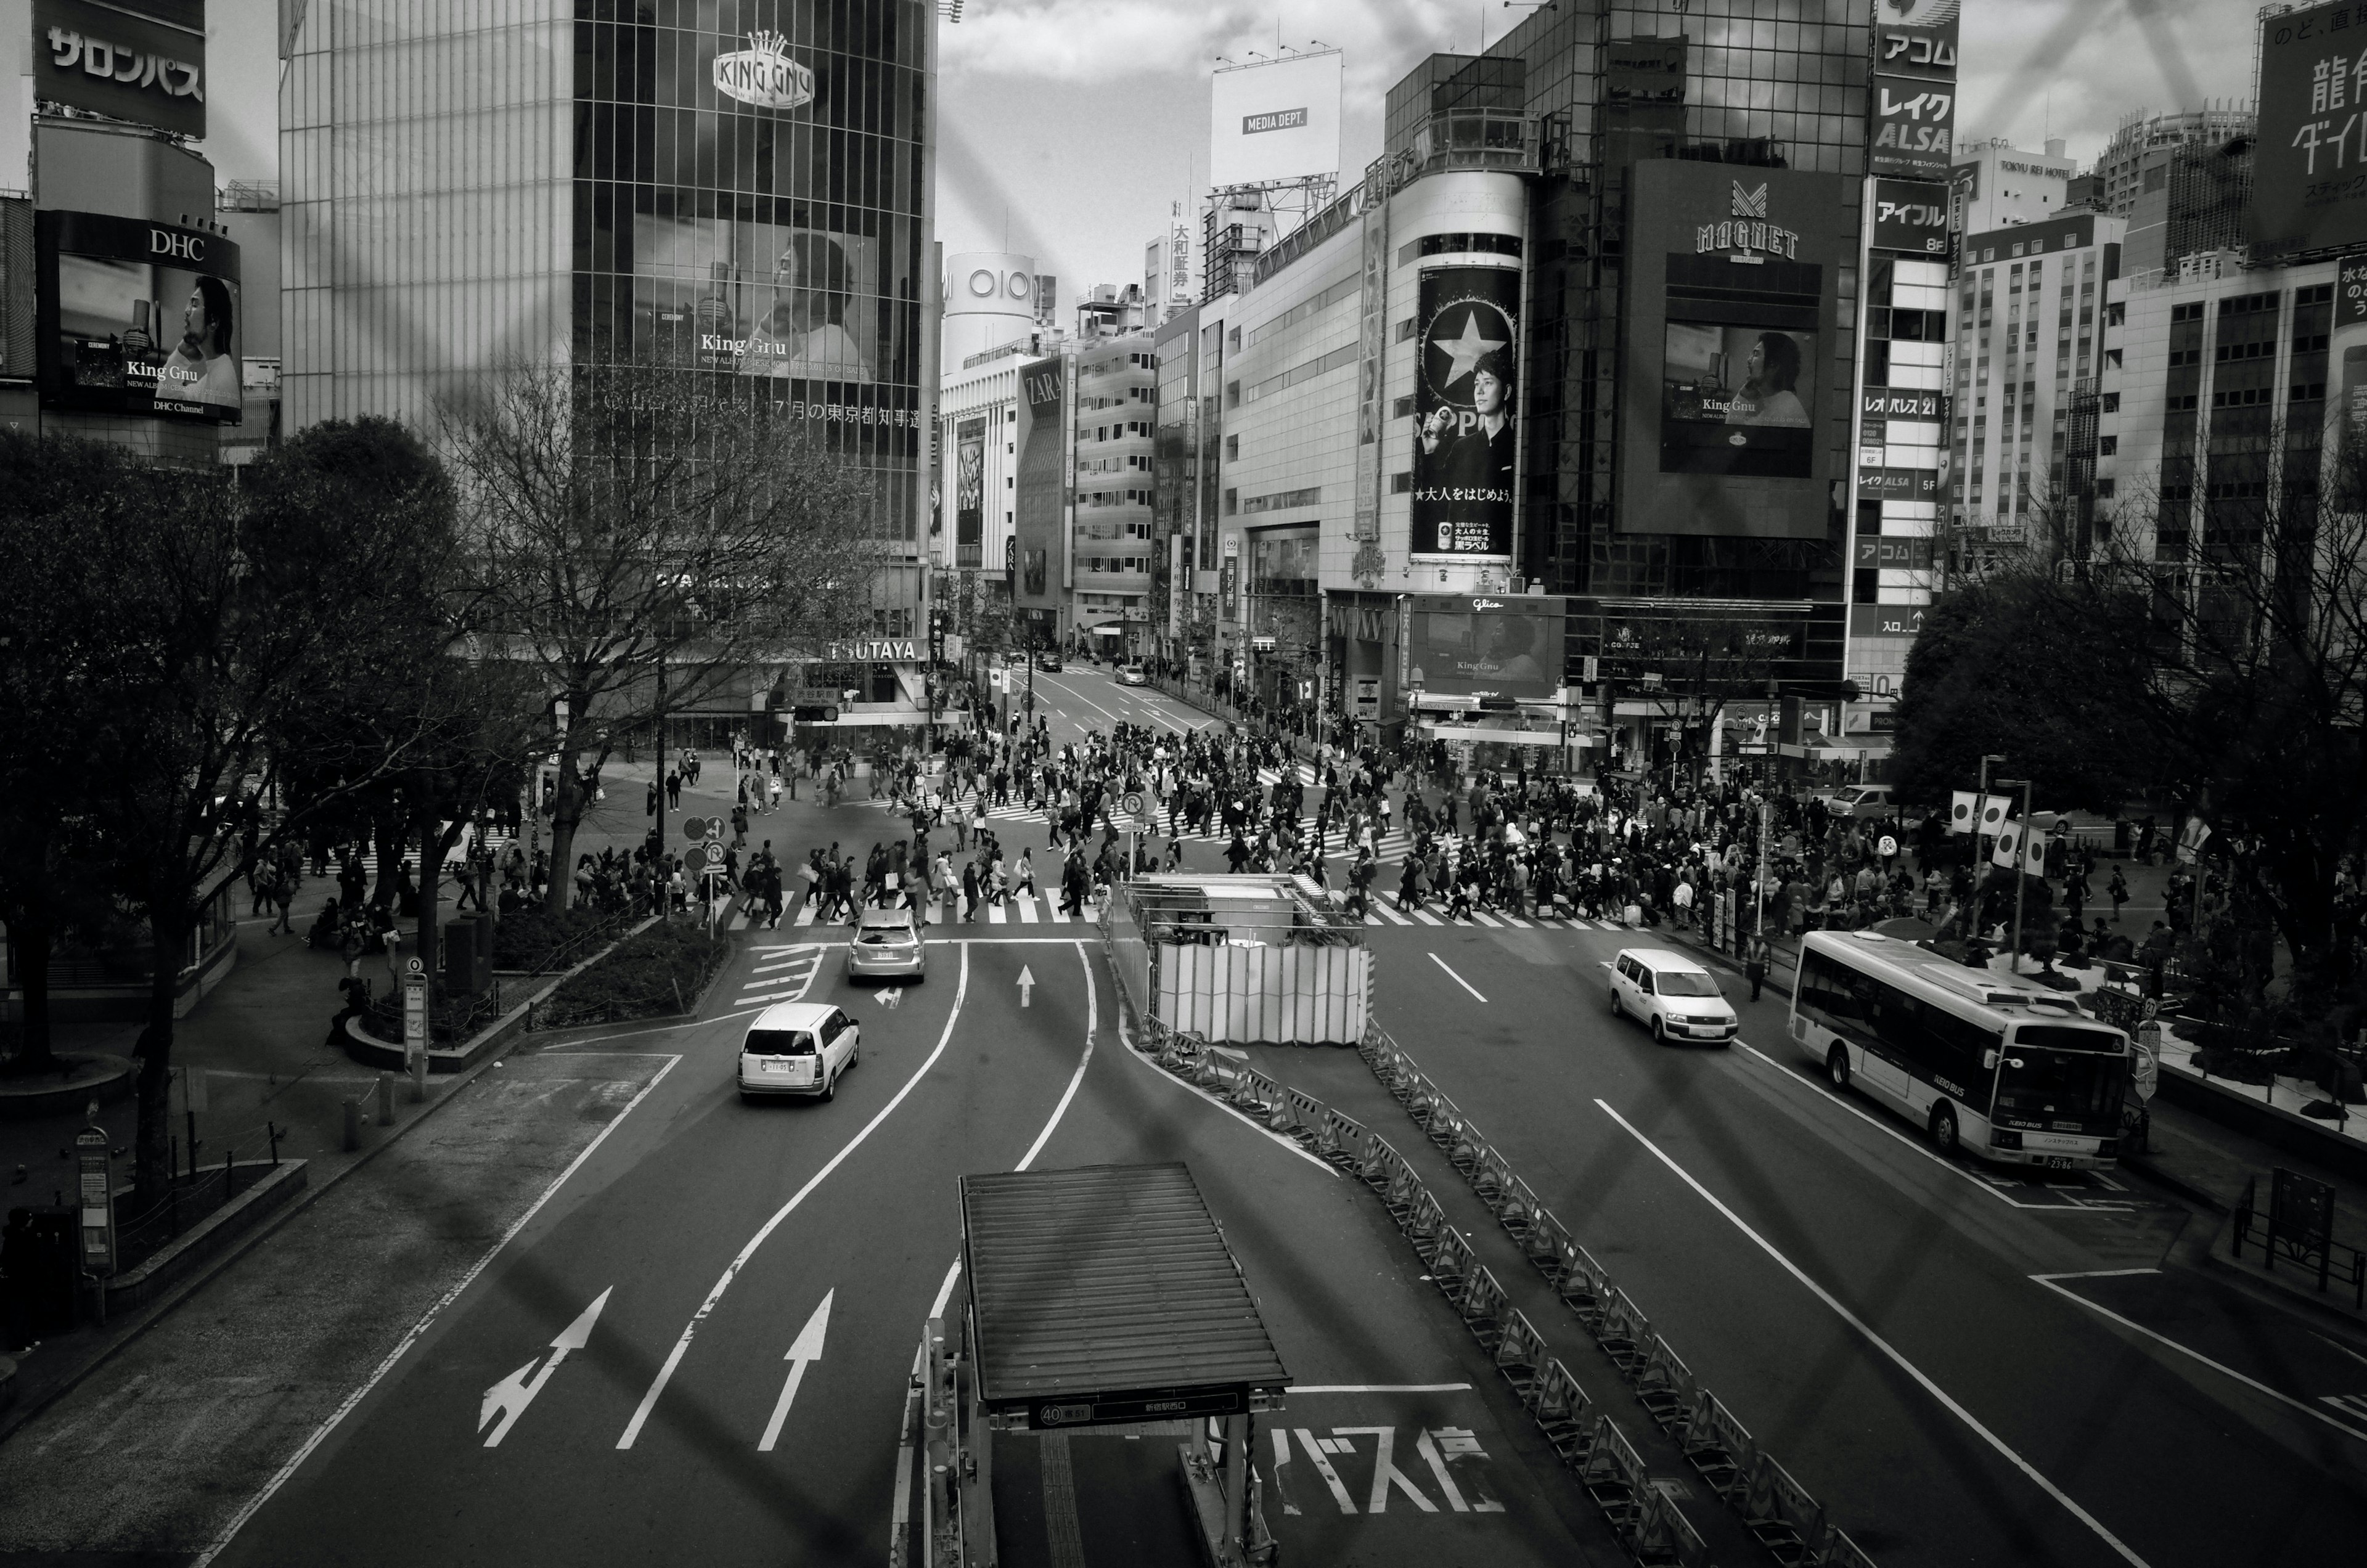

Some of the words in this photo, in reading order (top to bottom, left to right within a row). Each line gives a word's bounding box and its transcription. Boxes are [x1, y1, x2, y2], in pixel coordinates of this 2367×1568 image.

[1884, 33, 1956, 67] アコム
[47, 25, 203, 102] サロンパス
[719, 60, 765, 93] KING
[772, 64, 810, 95] GNU
[1880, 88, 1951, 121] レイク
[1248, 115, 1276, 131] MEDIA
[1278, 111, 1304, 127] DEPT.
[1874, 123, 1949, 154] ALSA
[2001, 160, 2028, 173] TOKYU
[2030, 165, 2043, 174] REI
[2045, 167, 2071, 179] HOTEL
[1878, 201, 1945, 227] アイフル
[150, 229, 205, 262] DHC
[1696, 221, 1799, 260] MAGNET
[1926, 238, 1944, 251] 8F
[1173, 224, 1189, 287] 大和証券
[1951, 244, 1960, 279] アイフル
[701, 334, 746, 356] King
[749, 338, 787, 356] Gnu
[126, 361, 166, 381] King
[169, 365, 198, 382] Gnu
[795, 362, 832, 372] 2020.01.5
[127, 380, 143, 388] NEW
[1026, 372, 1061, 405] ZARA
[153, 401, 173, 411] DHC
[174, 402, 204, 415] Channel
[1702, 399, 1731, 414] King
[1731, 401, 1756, 412] Gnu
[1866, 456, 1876, 464] 6F
[1859, 476, 1882, 486] レイク
[1884, 476, 1910, 487] ALSA
[1923, 480, 1936, 491] 5F
[1936, 504, 1945, 536] アコム
[1454, 541, 1490, 551] 黒ラベル
[1862, 544, 1909, 560] アコム
[1473, 598, 1504, 611] Glico
[1882, 621, 1901, 632] 入口
[1457, 661, 1479, 671] King
[797, 690, 835, 698] 渋谷駅前
[2146, 1001, 2156, 1018] 27
[1934, 1074, 1951, 1090] KEIO
[1949, 1083, 1966, 1097] BUS
[2008, 1119, 2027, 1127] KEIO
[2027, 1121, 2043, 1129] BUS
[1042, 1408, 1060, 1422] 40
[1064, 1409, 1073, 1418] 宿
[1074, 1409, 1085, 1418] 51
[1145, 1401, 1187, 1412] 新宿駅西口
